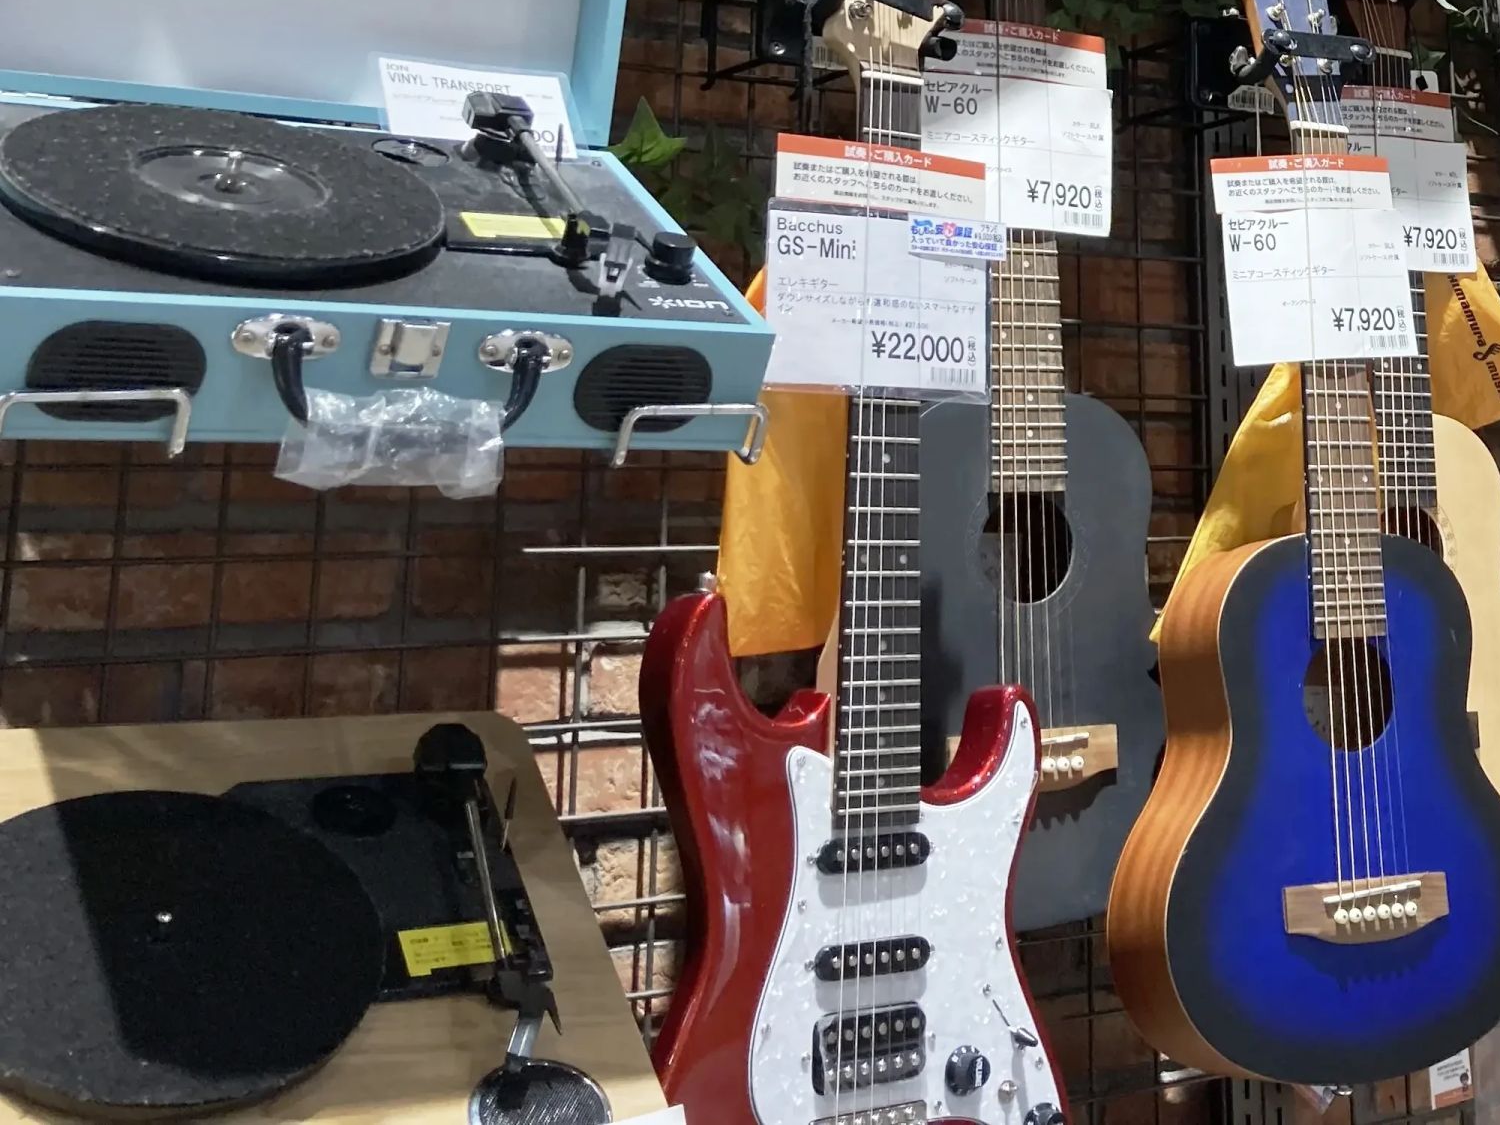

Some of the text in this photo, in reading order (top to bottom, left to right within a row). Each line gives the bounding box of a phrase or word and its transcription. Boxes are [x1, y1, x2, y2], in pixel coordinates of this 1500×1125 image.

[388, 72, 429, 86] VINYL
[925, 82, 993, 95] セピアクルー
[926, 96, 978, 115] W-60
[844, 145, 933, 168] 試奏・ご購入カード
[1268, 158, 1344, 170] 試奏・ご購入カード
[1027, 178, 1091, 209] ¥7,920
[777, 217, 844, 235] Bacchus
[1228, 219, 1289, 232] セピアクルー
[1229, 233, 1277, 252] W-60
[1403, 226, 1457, 250] ¥7,920
[777, 277, 838, 289] エレキギター
[777, 305, 793, 315] イン
[1332, 307, 1396, 332] ¥7,920
[871, 331, 964, 363] ¥22,000
